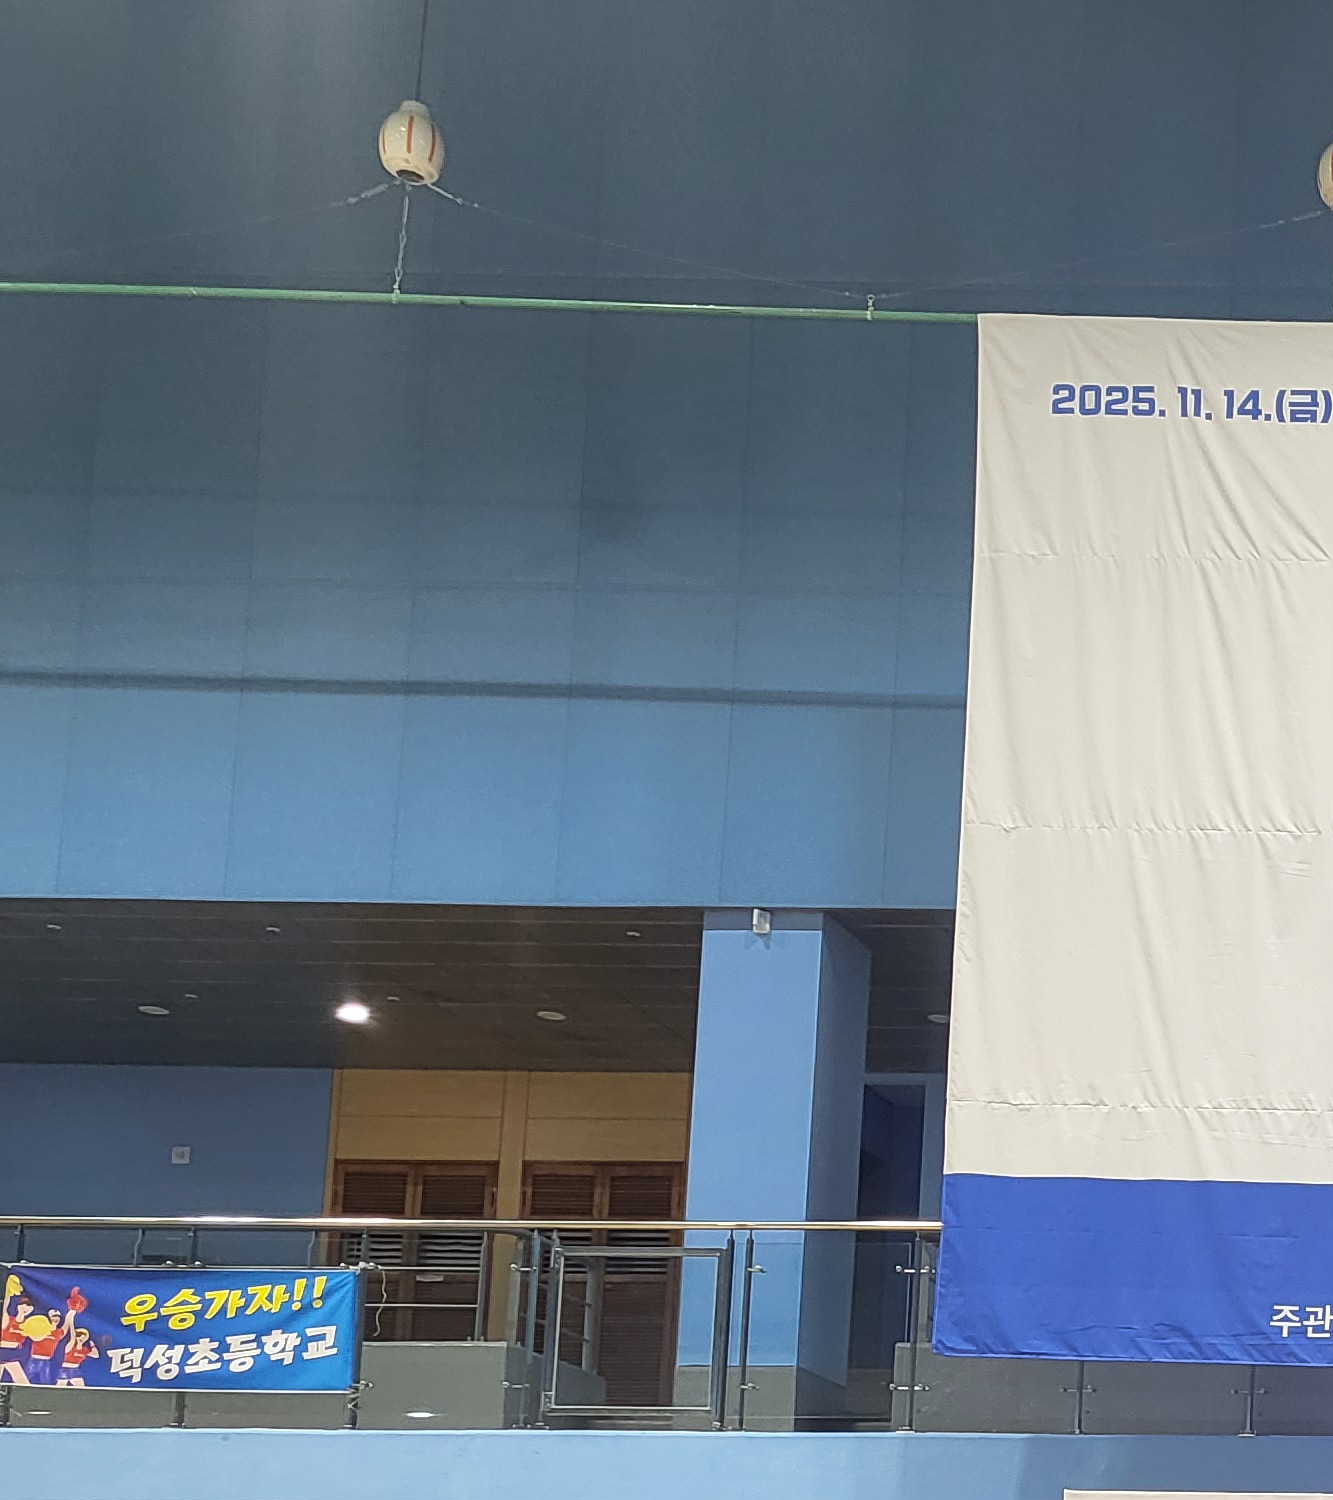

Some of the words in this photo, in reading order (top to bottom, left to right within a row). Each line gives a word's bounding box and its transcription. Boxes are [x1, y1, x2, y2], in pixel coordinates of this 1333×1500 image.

[1051, 383, 1166, 417] 2025.
[1177, 385, 1213, 420] 11.
[1224, 388, 1333, 424] 14.(금)
[120, 1275, 328, 1333] 우승가자!!
[106, 1324, 339, 1384] 덕성초등학교
